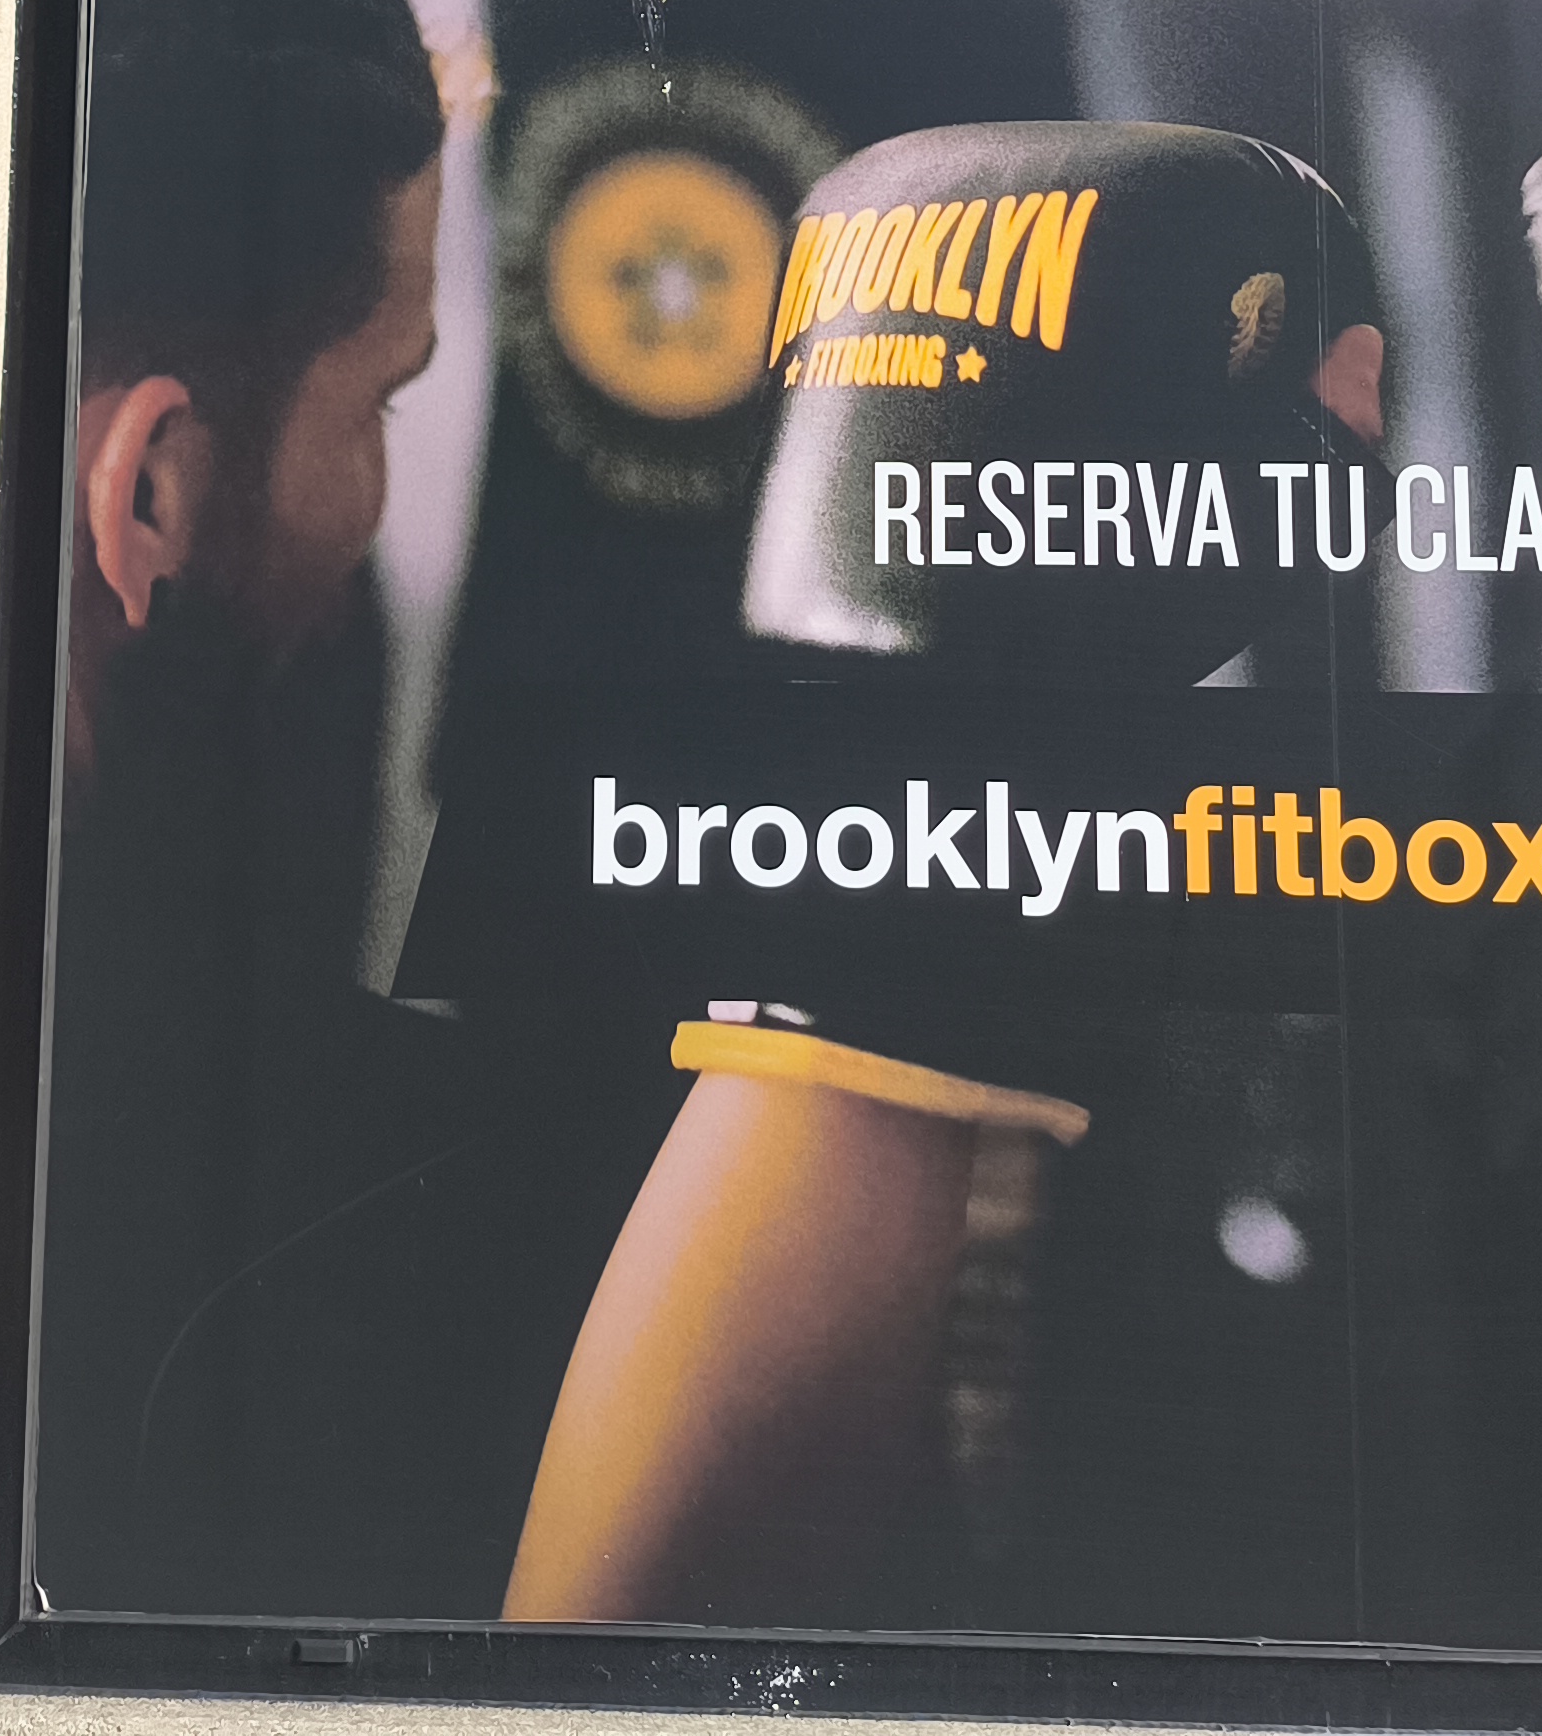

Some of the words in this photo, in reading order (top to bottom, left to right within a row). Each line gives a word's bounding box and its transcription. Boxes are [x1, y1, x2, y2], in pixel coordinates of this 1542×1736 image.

[769, 187, 1099, 370] BROOKLYN
[803, 332, 948, 390] FITBOXING
[873, 459, 1241, 568] RESERVA
[1259, 462, 1367, 573] TU
